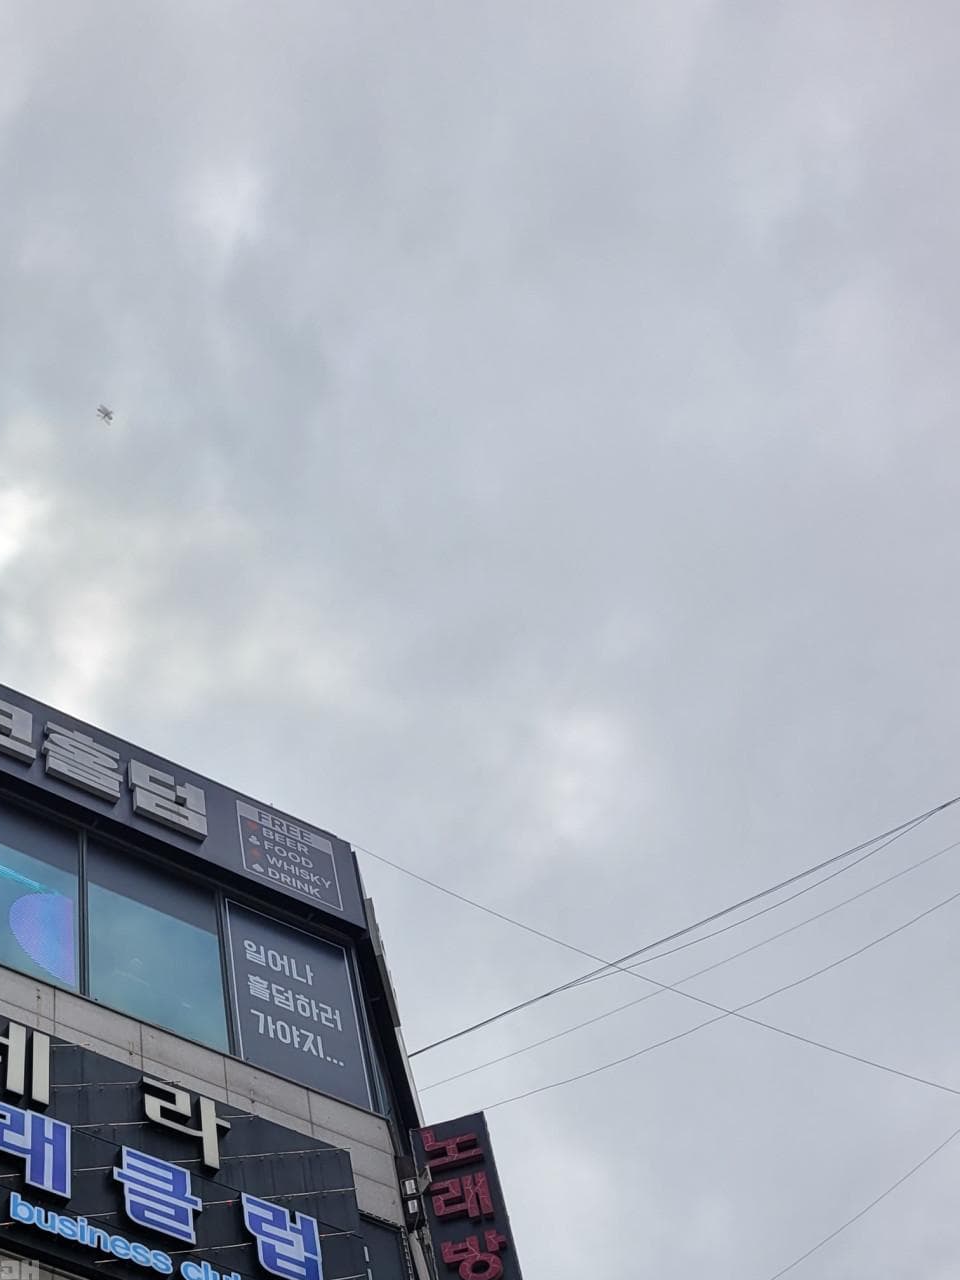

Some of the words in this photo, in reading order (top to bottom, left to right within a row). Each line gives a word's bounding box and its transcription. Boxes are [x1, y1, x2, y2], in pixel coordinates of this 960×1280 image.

[257, 811, 313, 845] FREE
[262, 827, 309, 855] BEER
[264, 841, 313, 868] FOOD
[266, 854, 331, 889] WHISKY
[268, 867, 322, 899] DRINK
[243, 939, 314, 986] 일어나
[247, 973, 343, 1032] 홀덤하러
[10, 1192, 174, 1275] business
